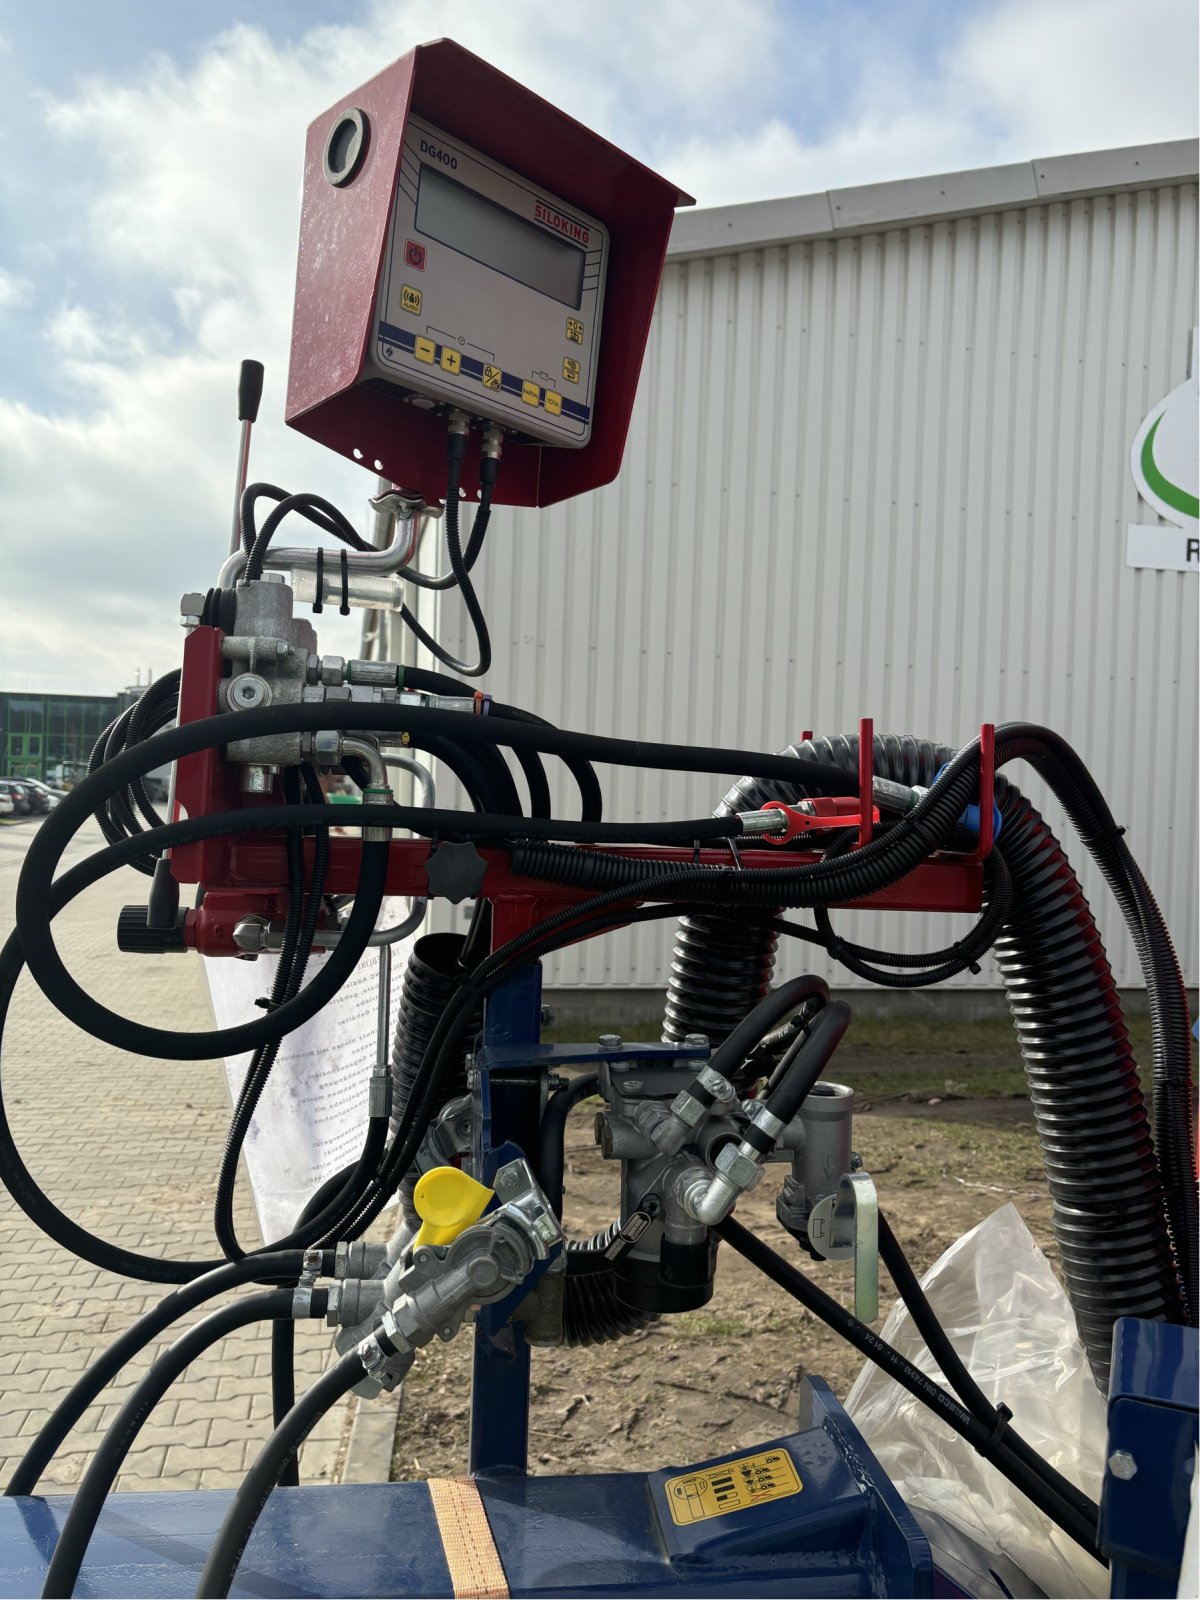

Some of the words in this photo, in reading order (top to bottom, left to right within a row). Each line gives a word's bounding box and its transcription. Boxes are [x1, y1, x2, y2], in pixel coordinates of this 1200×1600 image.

[420, 139, 458, 170] DG400
[534, 203, 590, 243] SILOKING
[547, 397, 560, 408] TOTAL
[922, 1382, 938, 1396] DIN
[938, 1394, 971, 1425] WABCO
